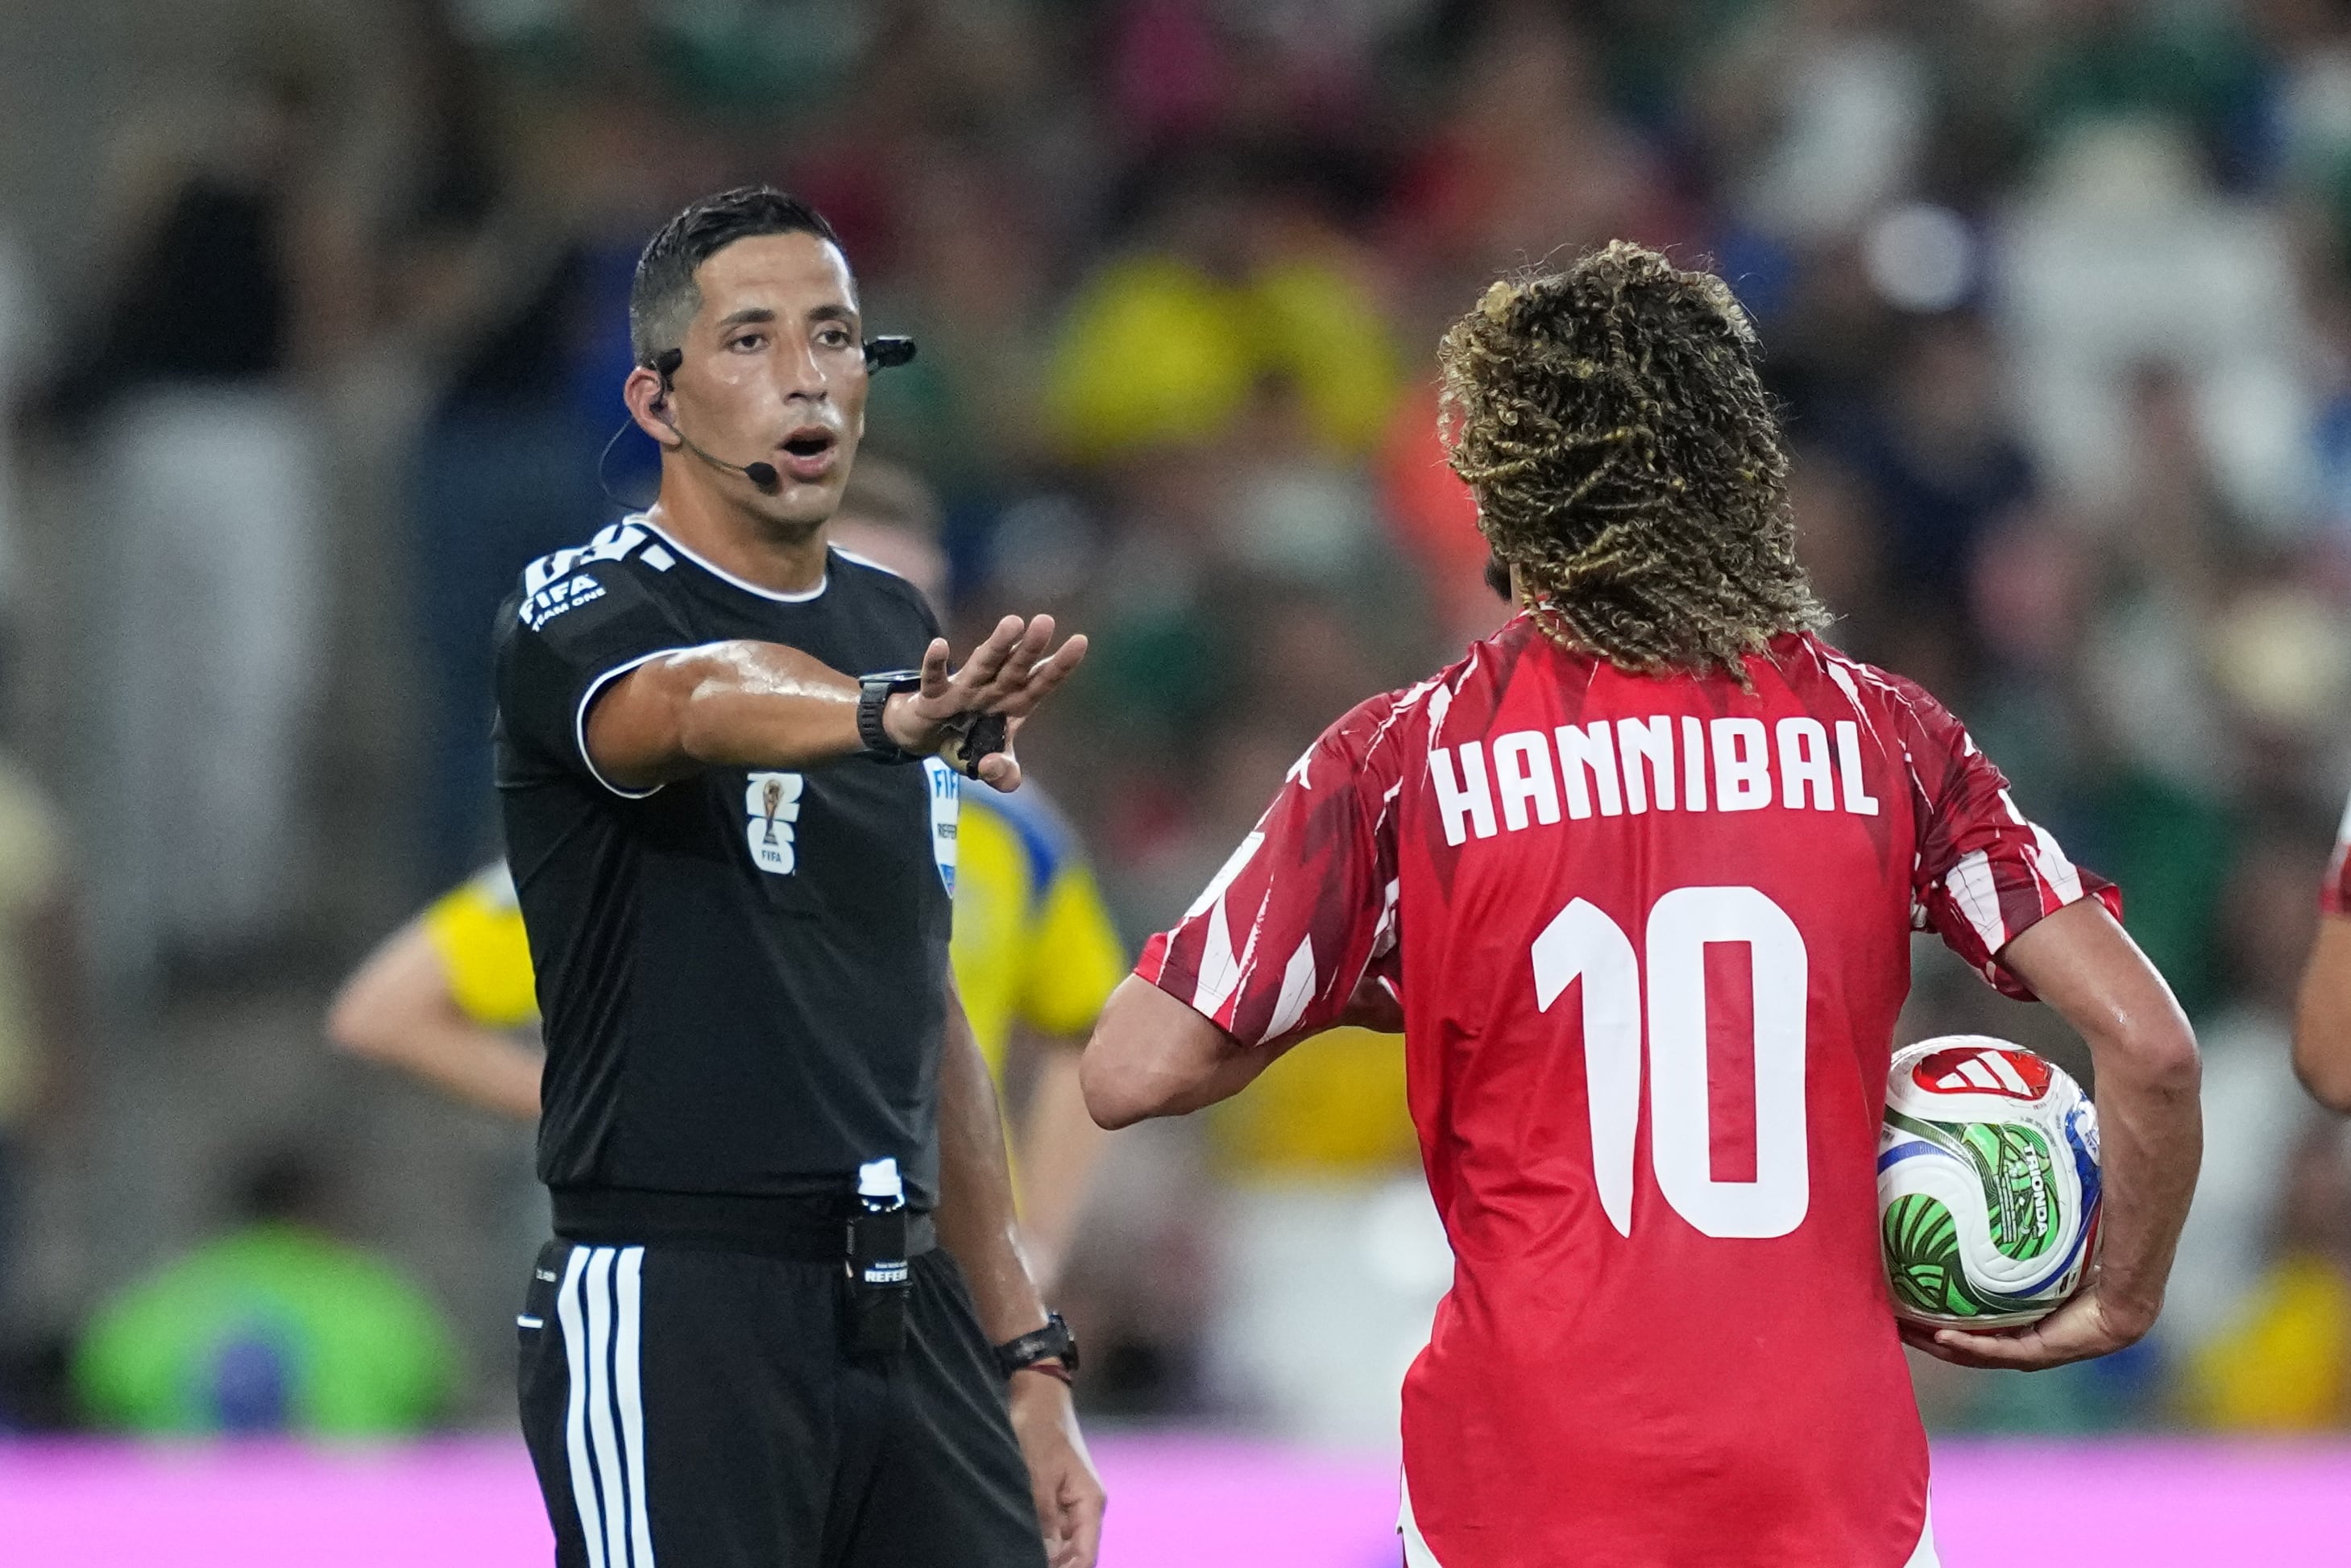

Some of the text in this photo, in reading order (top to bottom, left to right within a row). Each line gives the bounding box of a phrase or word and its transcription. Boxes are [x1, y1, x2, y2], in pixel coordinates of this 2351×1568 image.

[519, 575, 598, 624] FIFA
[532, 587, 606, 633] TEAM ONE
[1429, 715, 1878, 847] HANNIBAL
[761, 849, 782, 864] FIFA
[1532, 886, 1810, 1238] 10
[2023, 1142, 2048, 1238] TRIONDA
